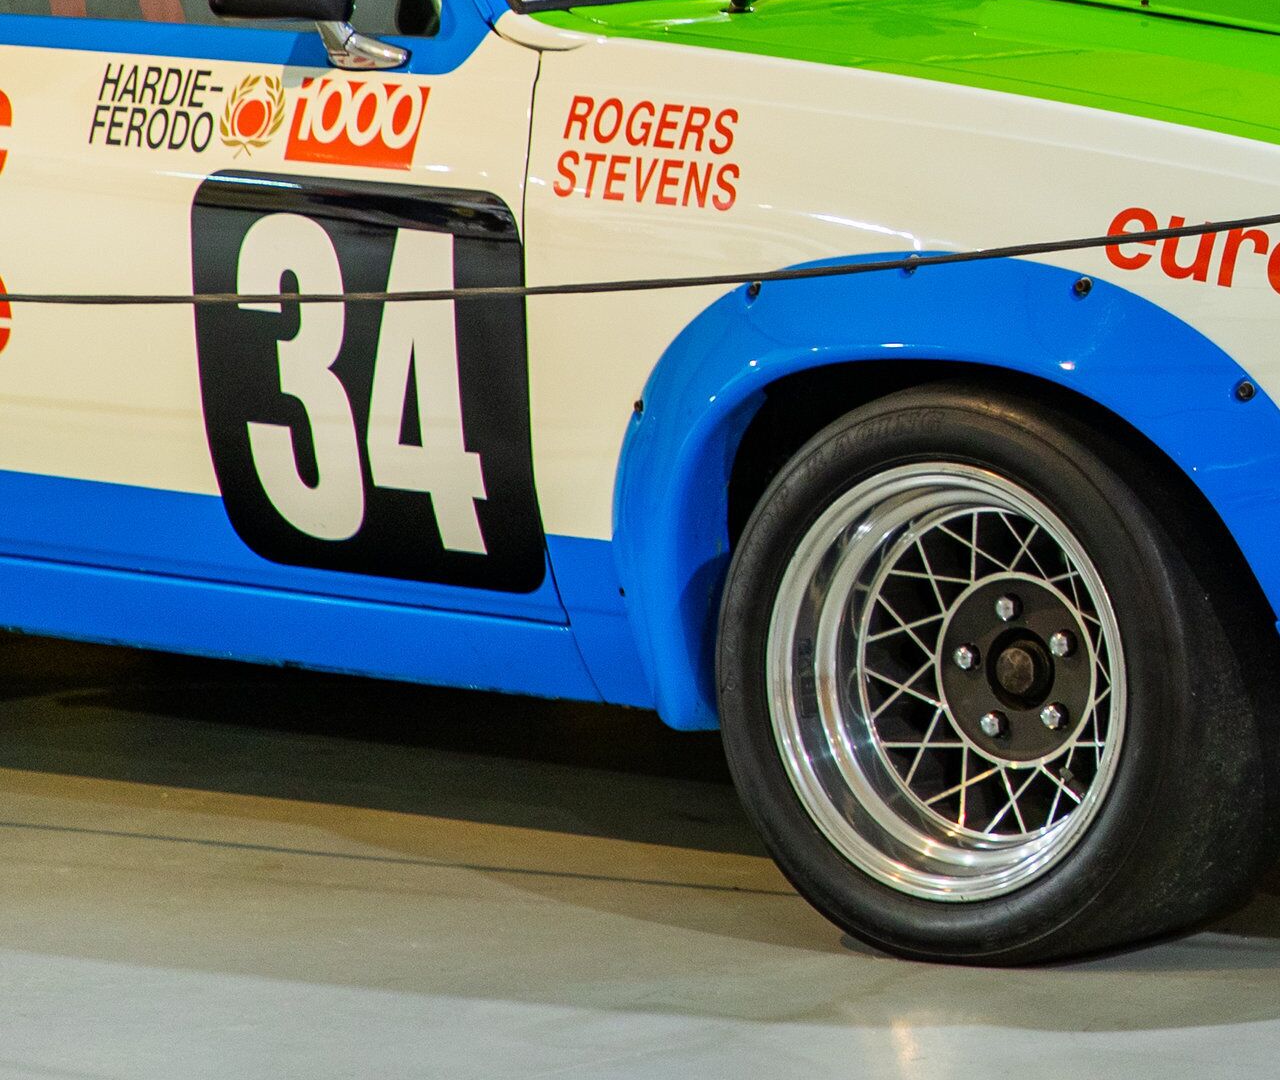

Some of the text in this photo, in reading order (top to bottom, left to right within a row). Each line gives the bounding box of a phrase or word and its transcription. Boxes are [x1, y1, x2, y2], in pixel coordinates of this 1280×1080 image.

[98, 62, 223, 108] HARDIE-
[297, 77, 423, 150] 1000
[88, 104, 214, 154] FERODO
[564, 94, 739, 155] ROGERS
[553, 150, 741, 212] STEVENS
[235, 211, 488, 557] 34
